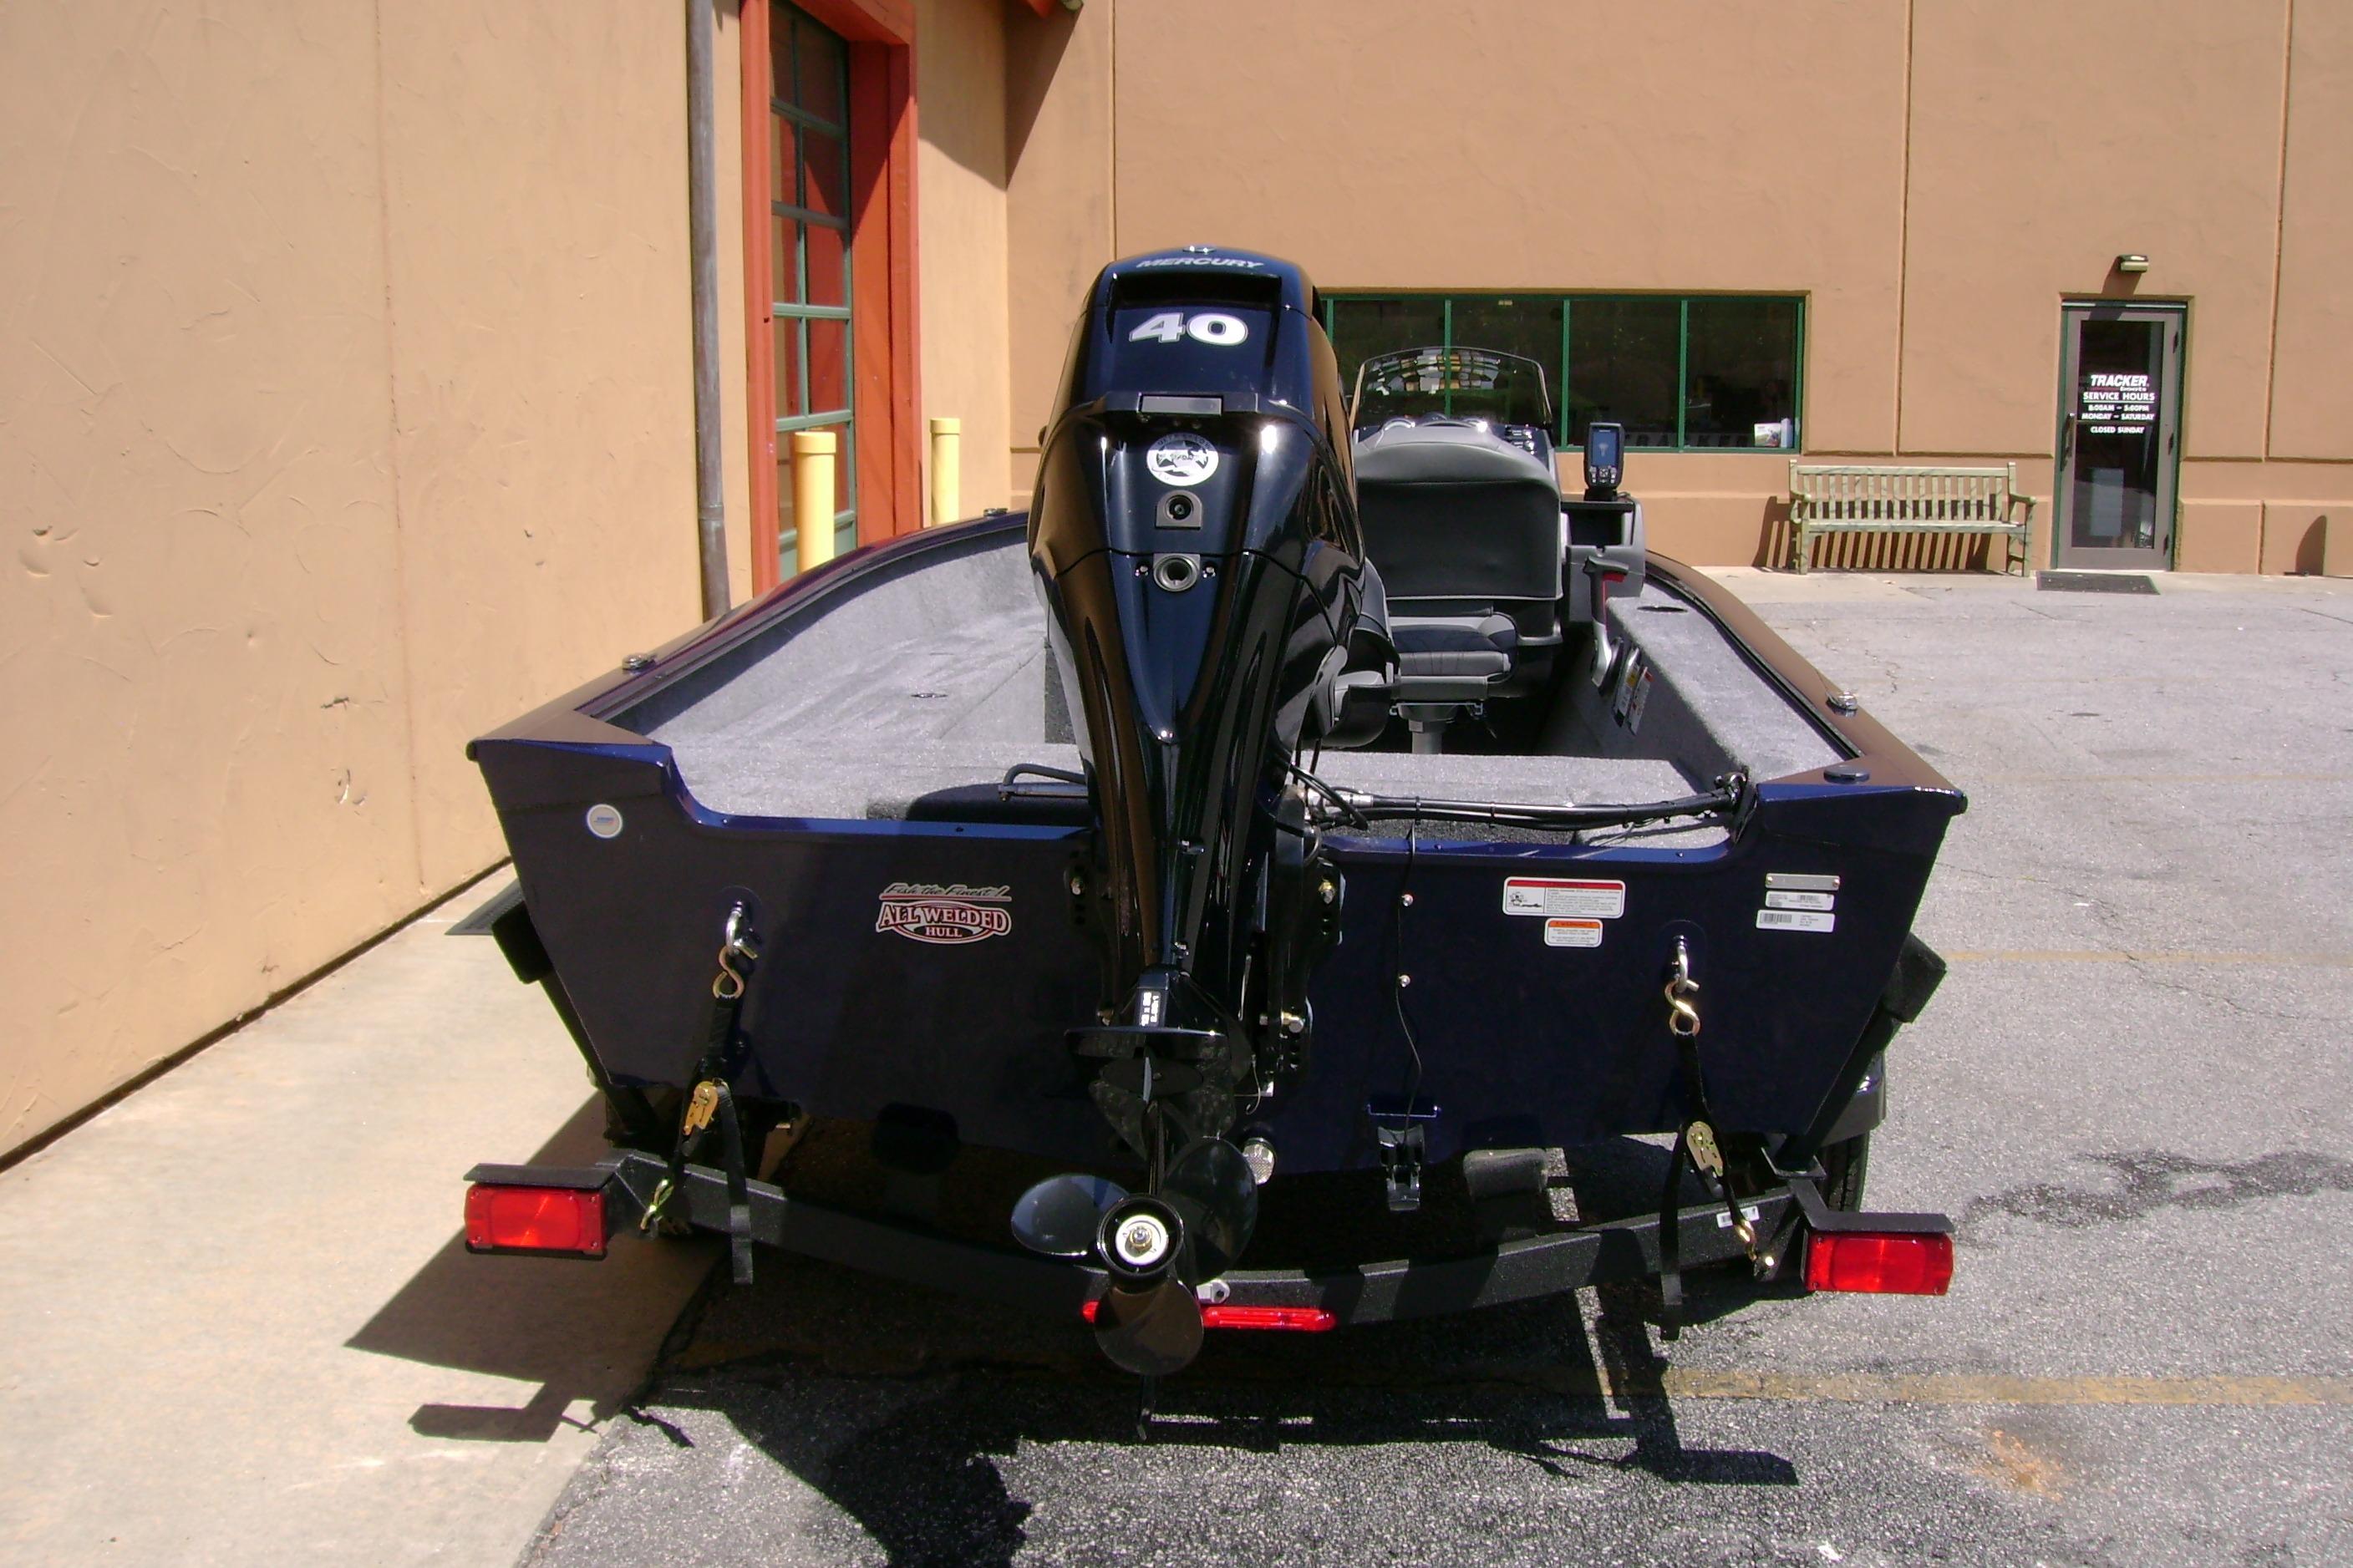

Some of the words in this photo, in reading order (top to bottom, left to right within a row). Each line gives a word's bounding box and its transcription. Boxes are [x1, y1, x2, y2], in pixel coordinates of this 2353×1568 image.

[1136, 257, 1264, 268] MERCURY
[1129, 312, 1248, 347] 40
[2091, 374, 2148, 386] TRACKER
[2083, 392, 2119, 400] SERVICE
[2122, 393, 2155, 401] HOURS
[879, 904, 919, 927] ALL
[922, 906, 1008, 932] WELDED
[925, 926, 963, 938] HULL
